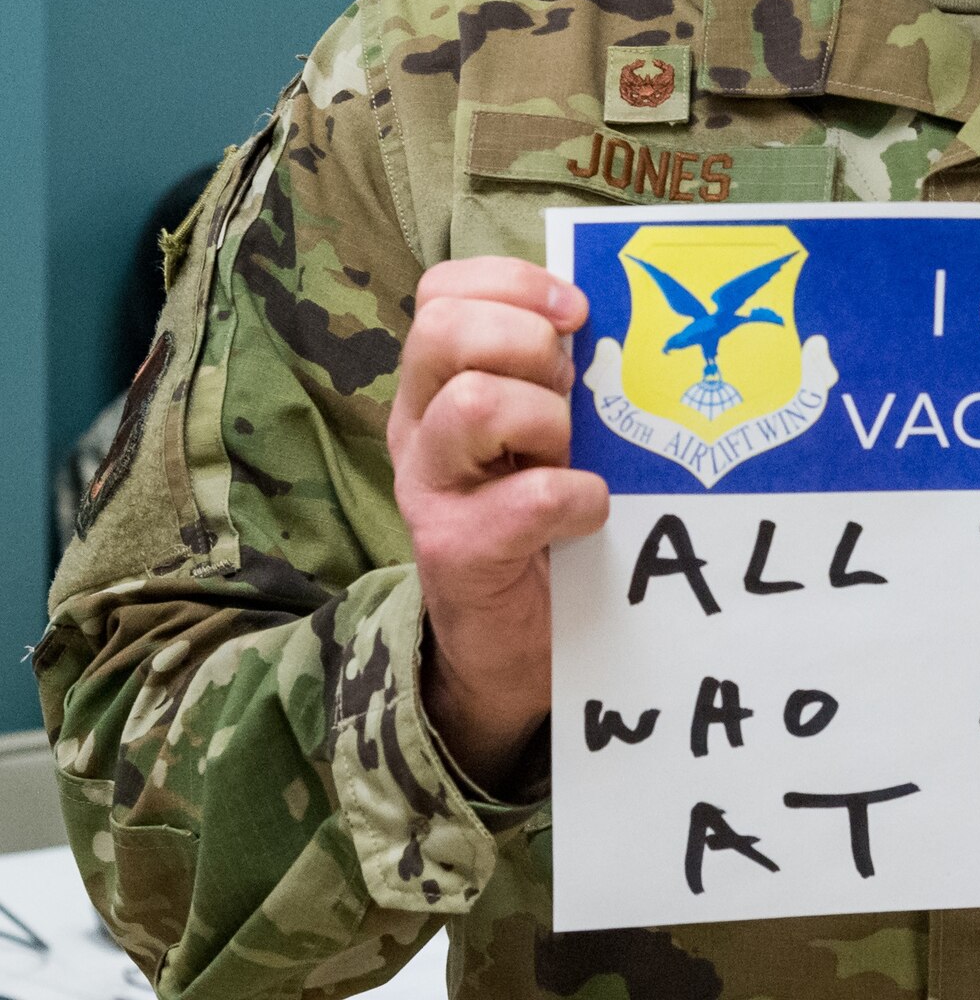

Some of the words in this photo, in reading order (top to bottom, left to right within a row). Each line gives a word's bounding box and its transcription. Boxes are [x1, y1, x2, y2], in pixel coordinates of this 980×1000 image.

[566, 132, 733, 201] JONES
[933, 269, 946, 336] I
[601, 393, 655, 445] 436TH
[663, 425, 755, 475] AIRLIFT
[757, 388, 823, 441] WING
[628, 514, 888, 616] ALL
[584, 676, 839, 758] WHO
[684, 782, 921, 895] AT
